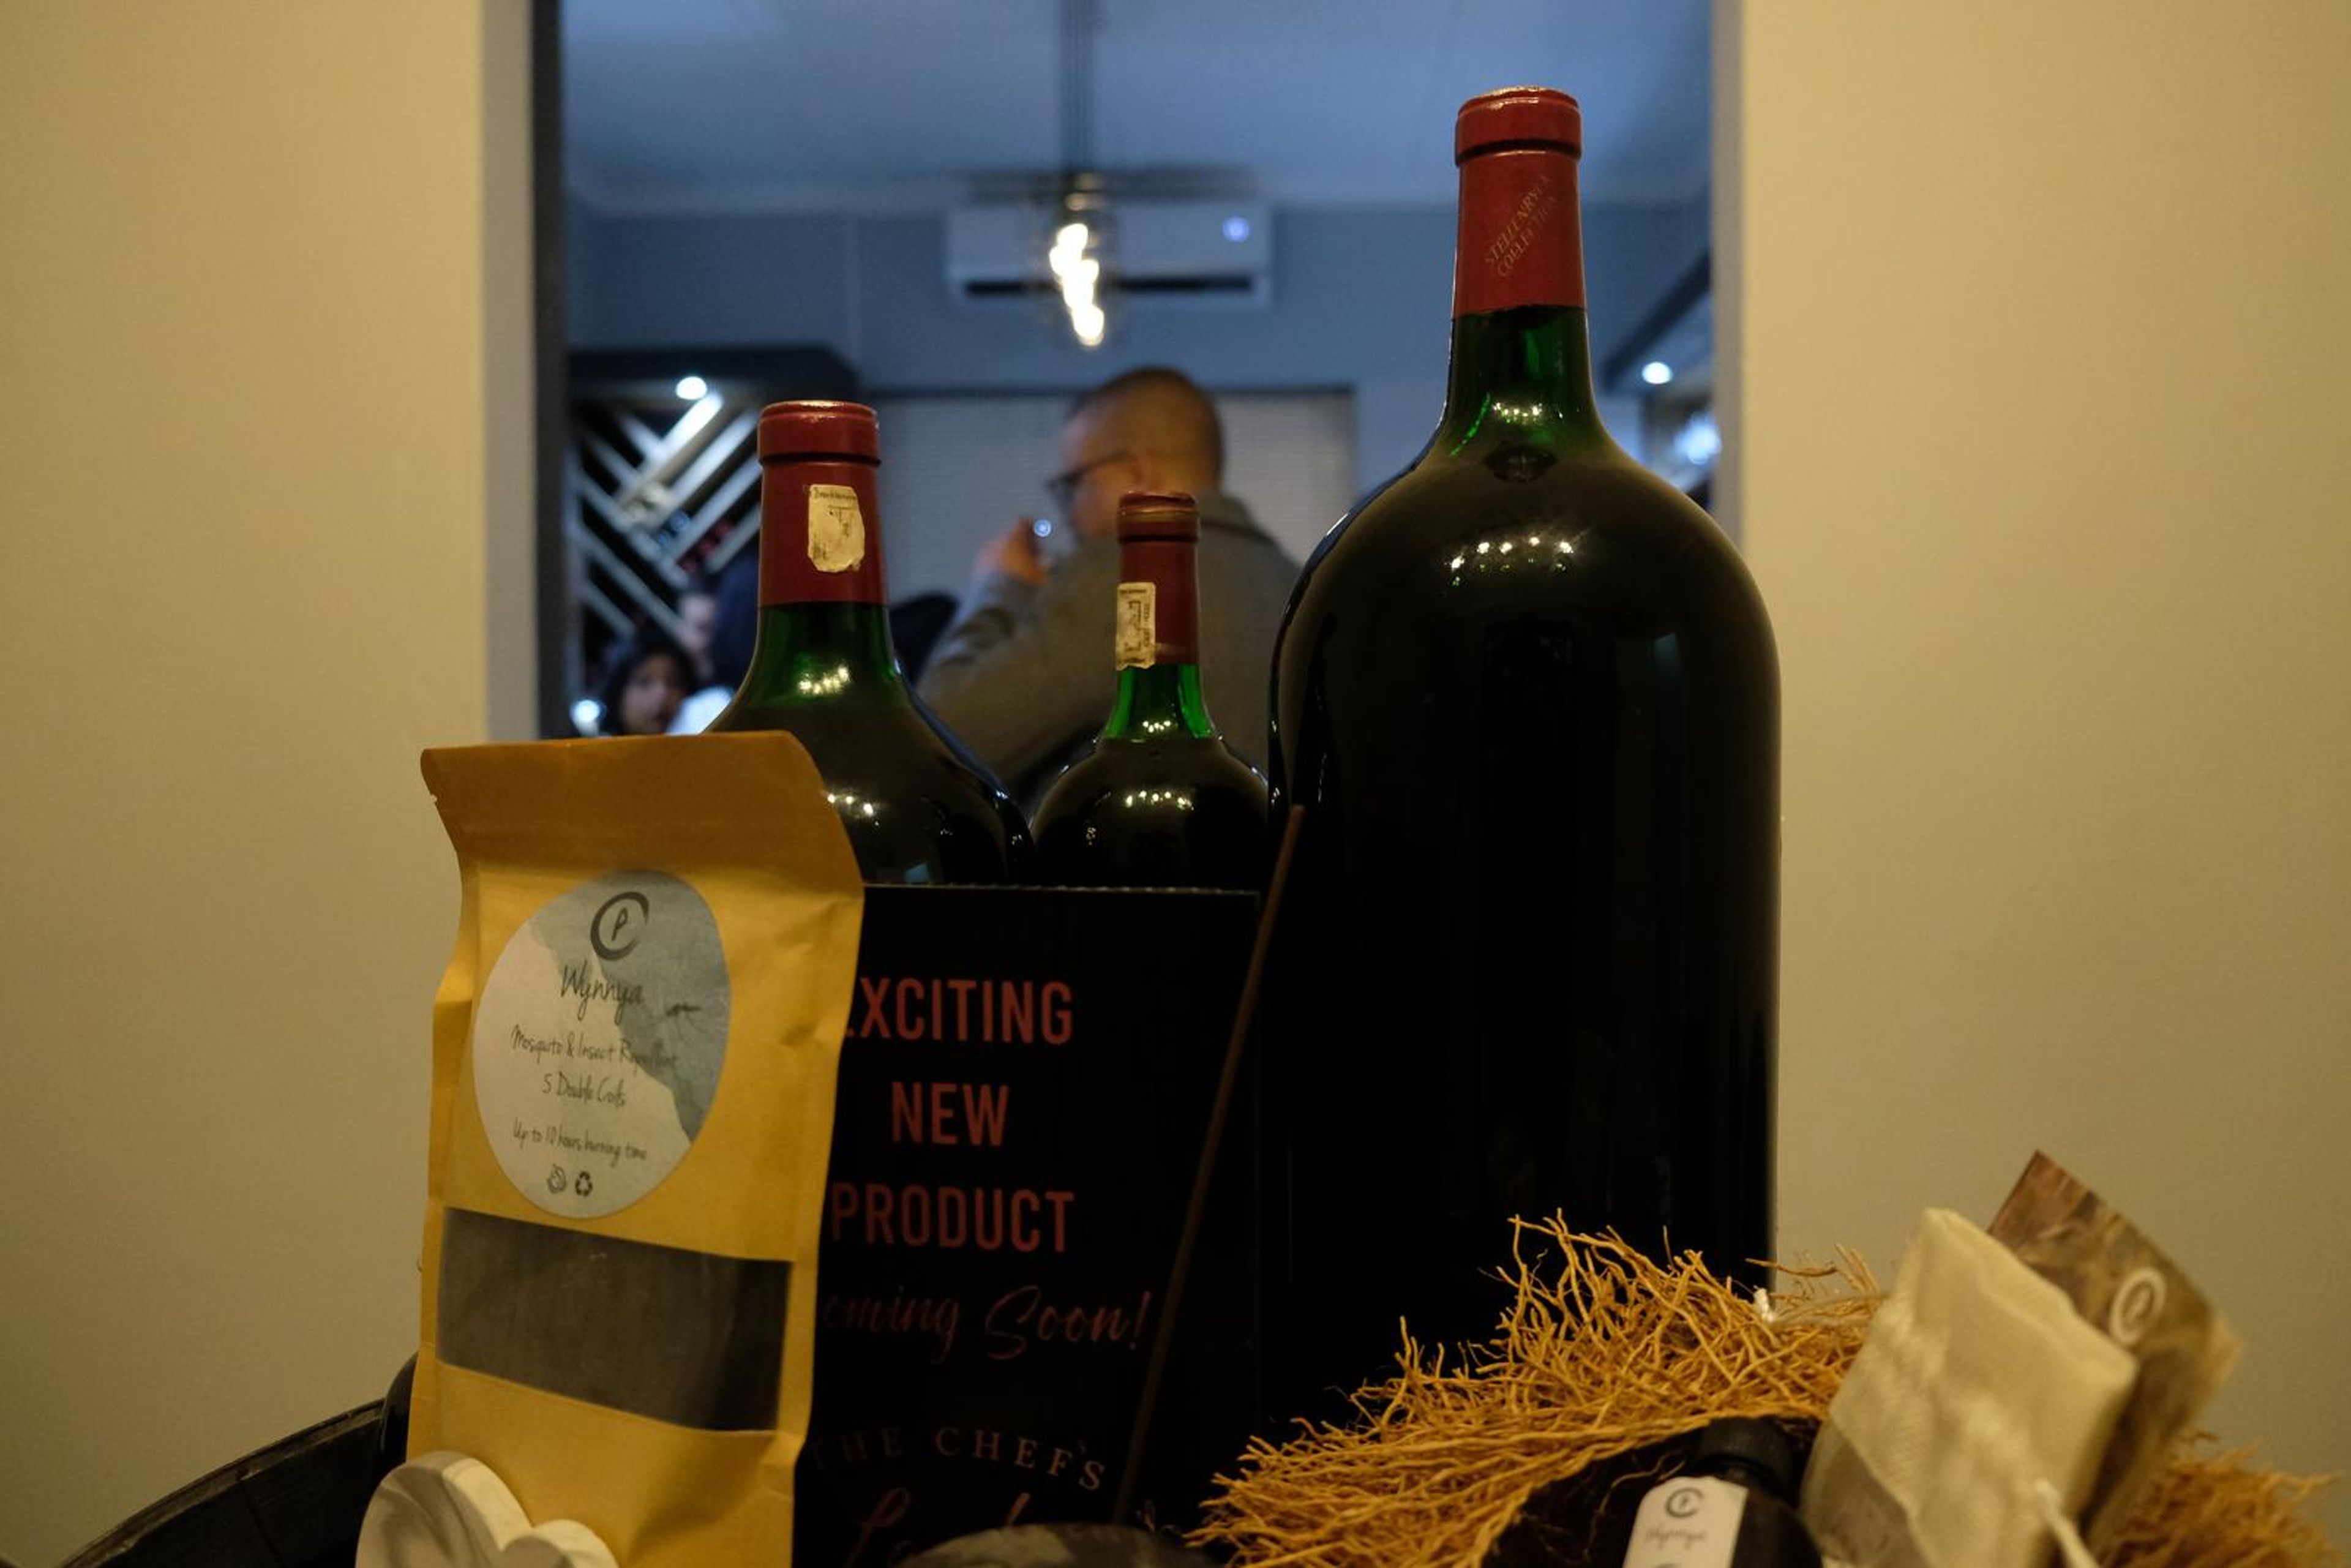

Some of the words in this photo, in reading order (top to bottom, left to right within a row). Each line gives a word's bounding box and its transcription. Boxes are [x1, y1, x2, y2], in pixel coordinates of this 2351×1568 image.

[846, 977, 1074, 1045] XCITING
[891, 1081, 1010, 1147] NEW
[831, 1181, 1074, 1253] PRODUCT
[822, 1283, 960, 1365] oming
[985, 1284, 1153, 1361] Soon!
[935, 1426, 1106, 1491] CHEF'S
